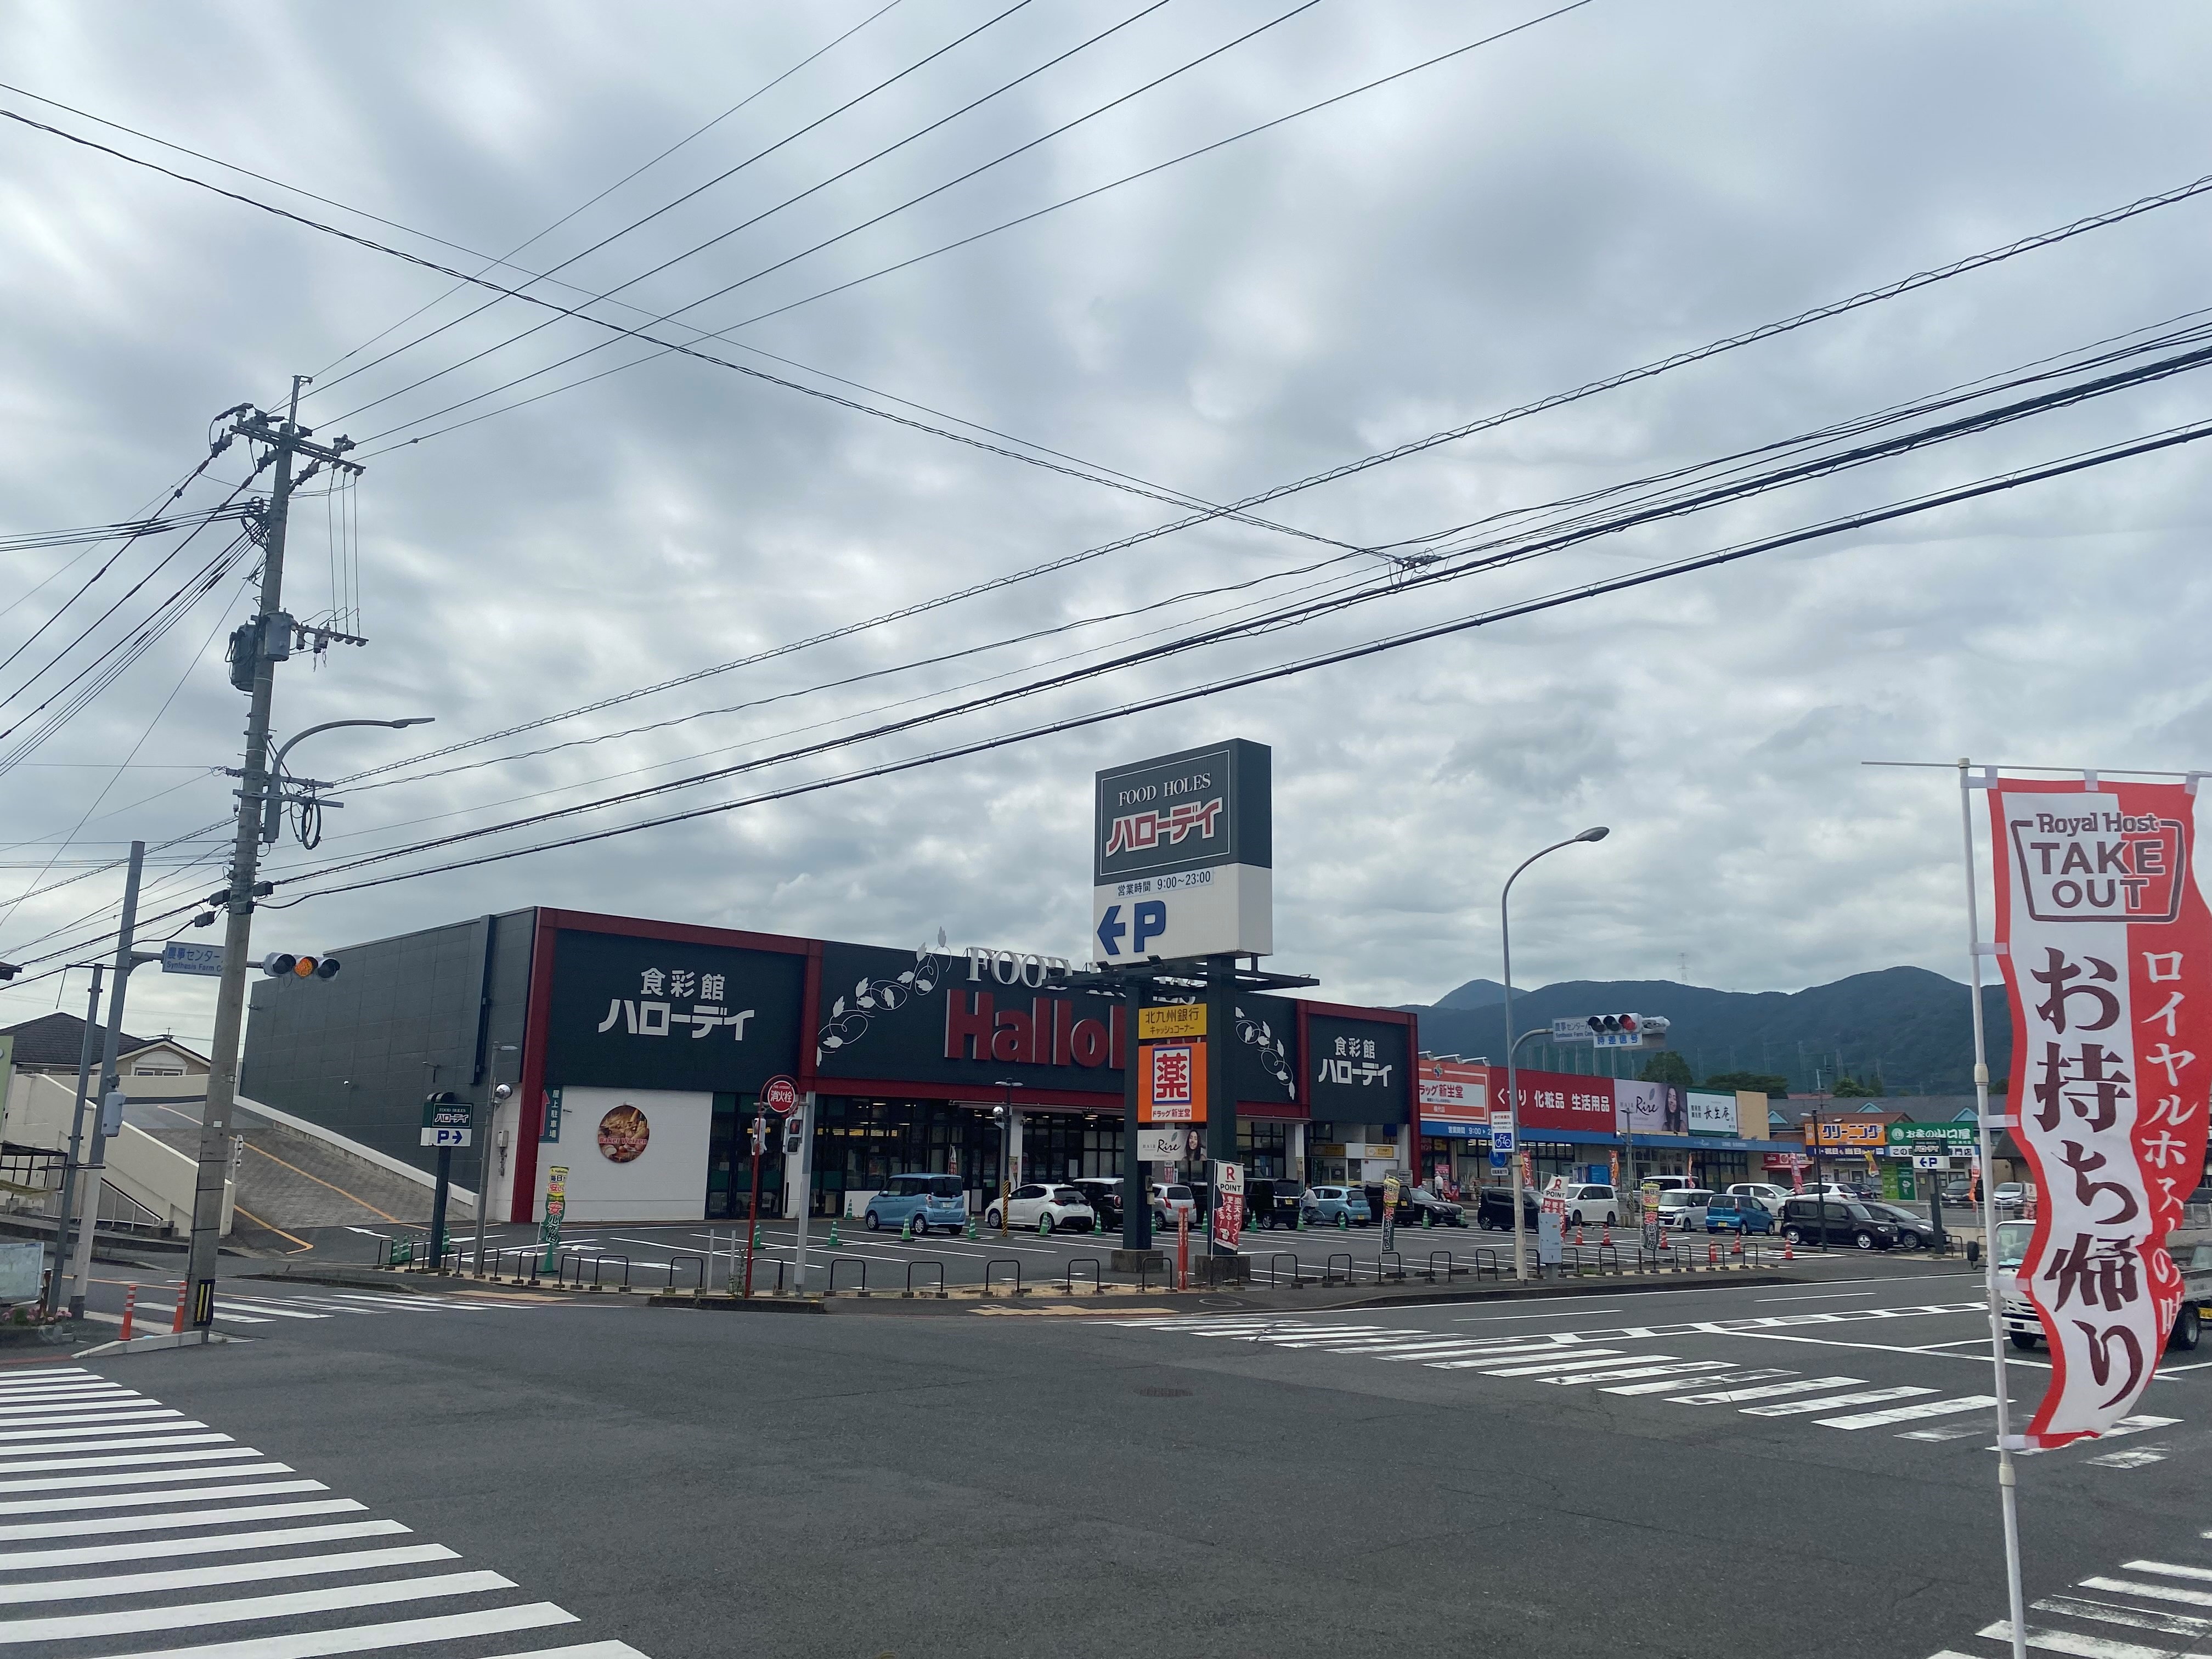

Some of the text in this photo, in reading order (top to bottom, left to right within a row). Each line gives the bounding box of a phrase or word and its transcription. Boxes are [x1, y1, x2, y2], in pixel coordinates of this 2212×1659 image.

[1118, 772, 1212, 807] FOOD HOLES
[2036, 811, 2160, 837] Royal Host
[2030, 840, 2165, 875] TAKE
[1118, 881, 1151, 897] 営業時間
[2052, 879, 2148, 909] OUT
[1133, 900, 1166, 952] P
[167, 947, 223, 962] 農事センター
[167, 961, 196, 970] Synthesis
[640, 967, 725, 1001] 食彩館
[1145, 1007, 1199, 1024] 北九州銀行
[1150, 1024, 1194, 1035] キャッシュコーナー
[1597, 1034, 1639, 1045] 時差信号
[1334, 1036, 1375, 1059] 食彩館
[1156, 1052, 1187, 1098] 薬
[770, 1090, 793, 1103] 消火栓
[1439, 1084, 1464, 1098] 新生堂
[1498, 1088, 1610, 1113] くり 化粧品 生活用品
[437, 1130, 449, 1144] P
[1822, 1125, 1883, 1139] クリーニング
[621, 1137, 647, 1145] Weizen
[1156, 1139, 1181, 1153] Rire
[1929, 1158, 1937, 1167] P
[2030, 947, 2143, 1410] お持ち帰り
[1220, 1183, 1242, 1192] POINT
